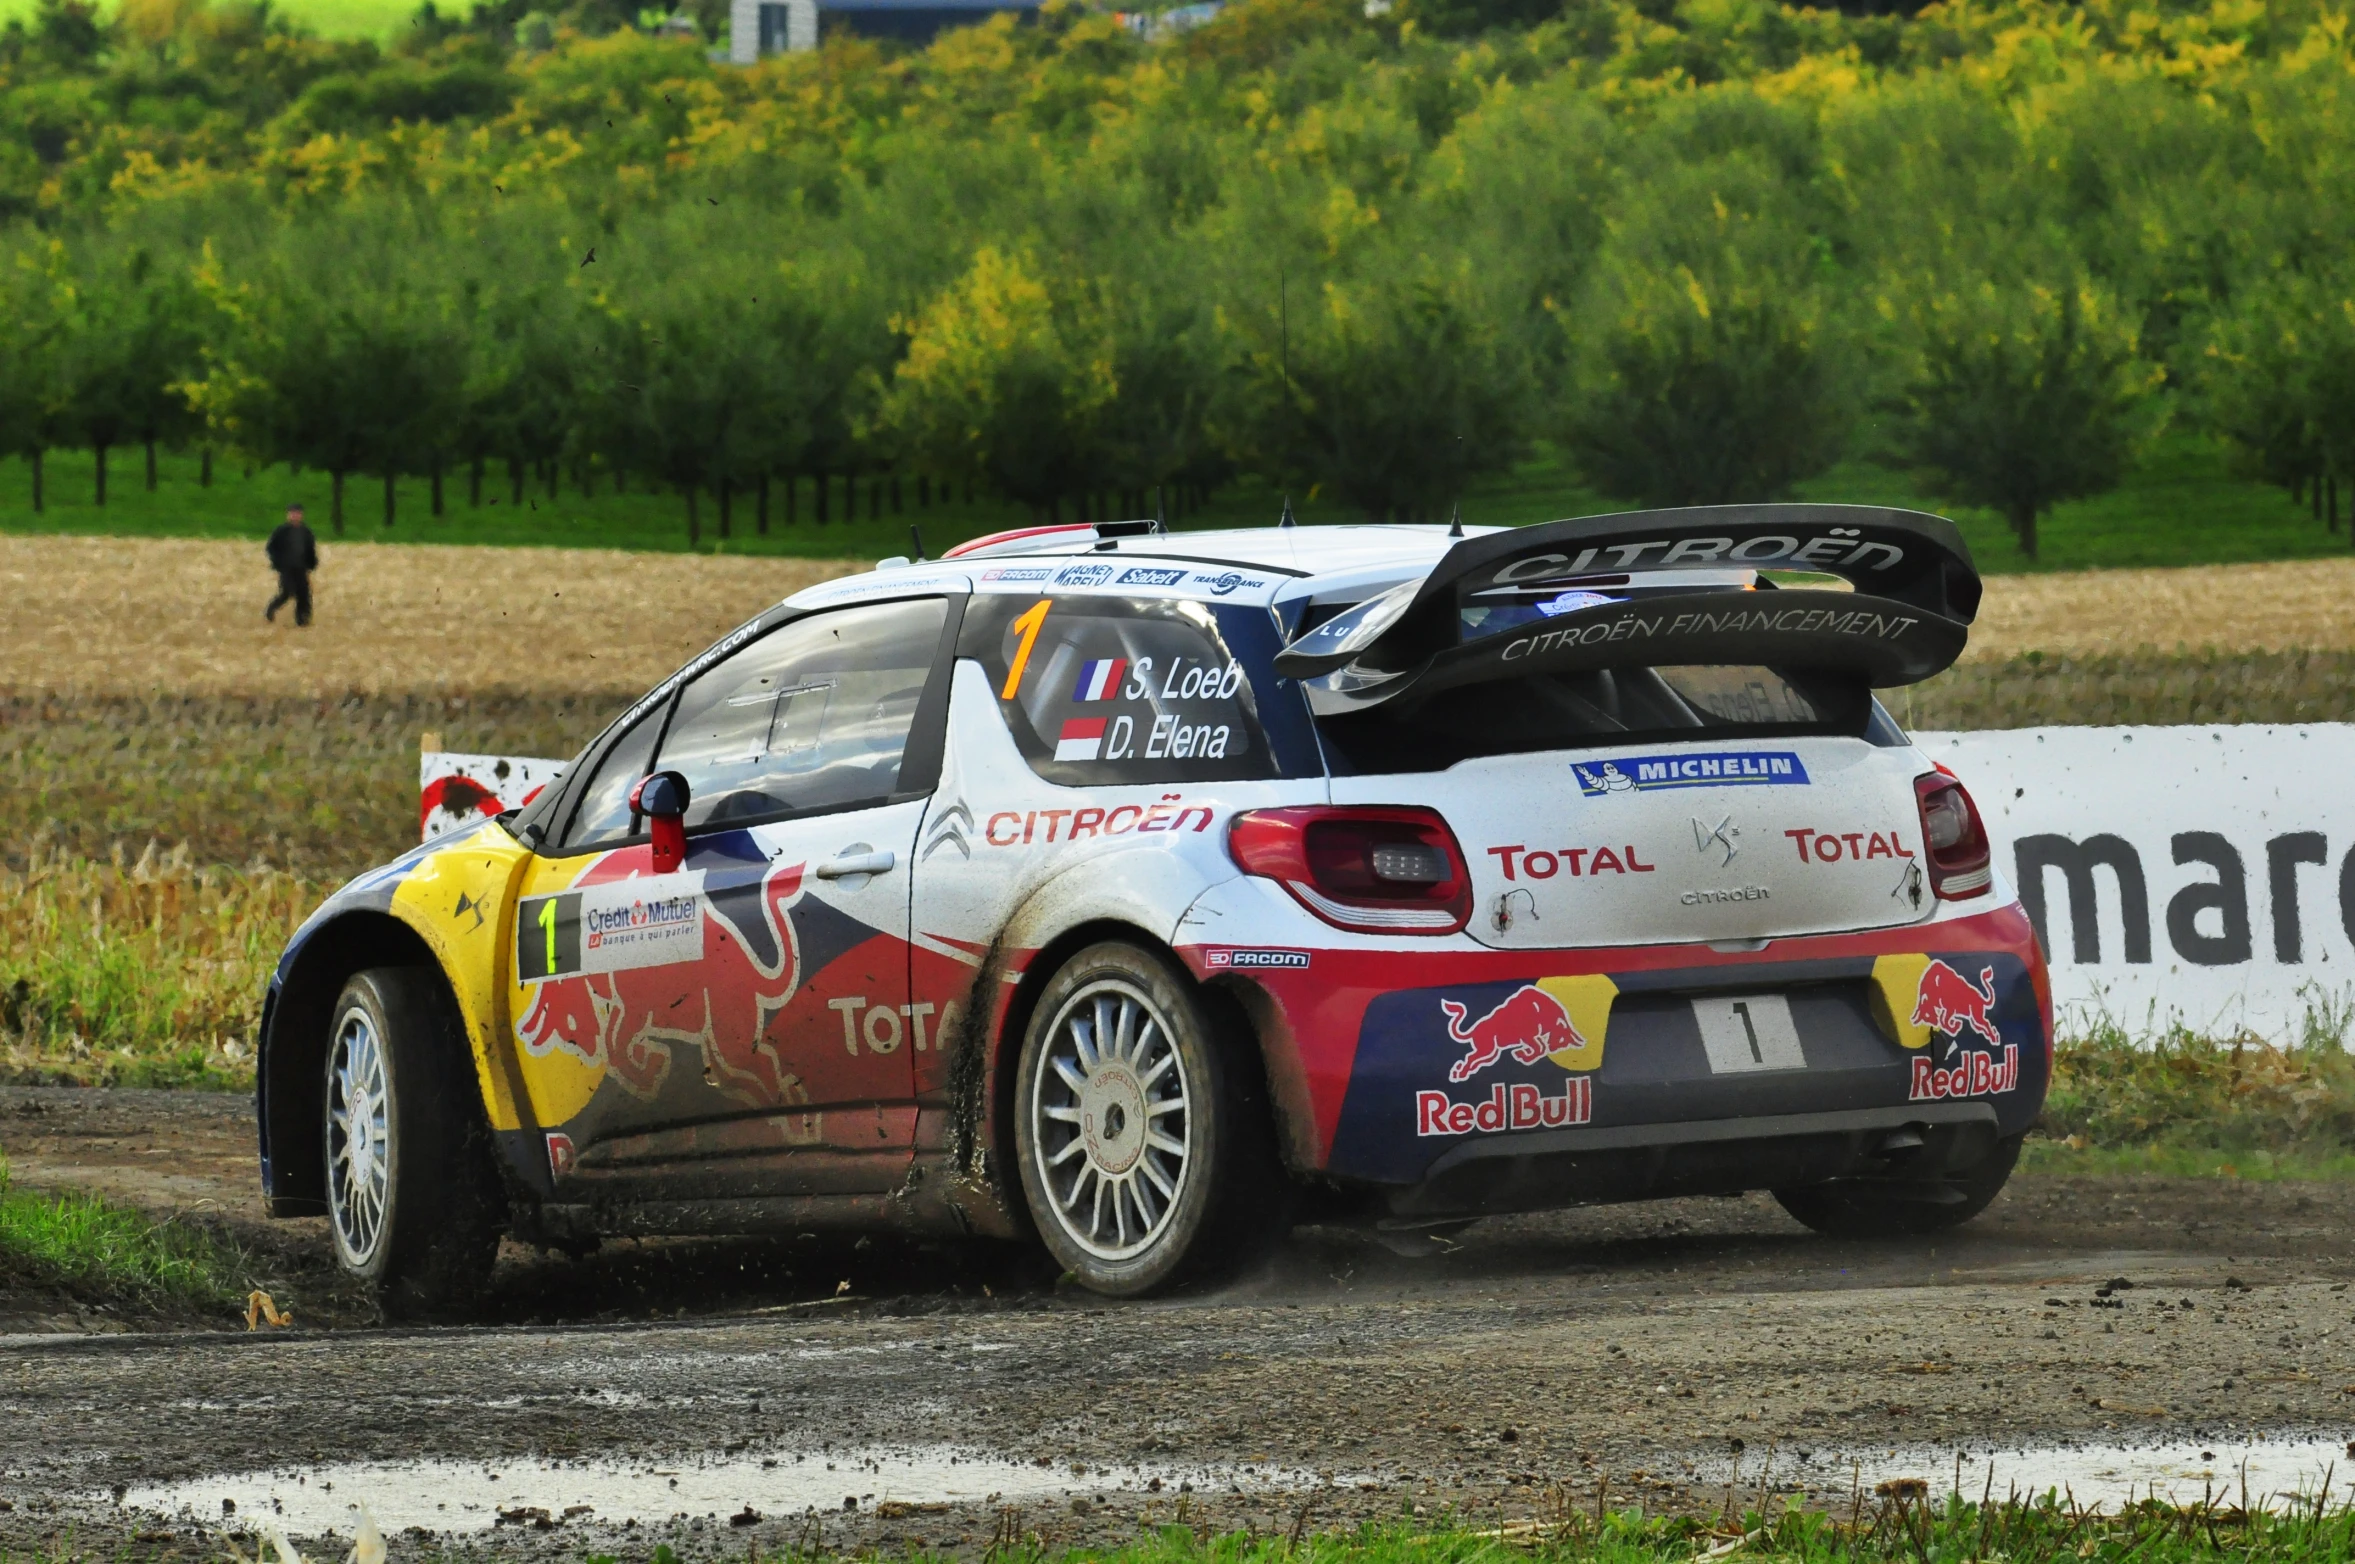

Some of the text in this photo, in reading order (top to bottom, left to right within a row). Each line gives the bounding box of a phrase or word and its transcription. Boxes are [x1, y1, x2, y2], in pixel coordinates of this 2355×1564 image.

[1003, 570, 1049, 580] FACOM
[1124, 569, 1180, 585] Sabelt
[1001, 600, 1052, 699] 1
[1501, 609, 1919, 661] CITROËN FINANCEMENT
[1125, 657, 1243, 700] S. Loeb
[1104, 715, 1231, 759] D. Elena
[1638, 754, 1793, 780] MICHELIN
[1488, 845, 1655, 881] TOTAL
[588, 896, 697, 932] Crédit Mutuel
[2013, 831, 2355, 966] mar
[537, 898, 558, 975] 1
[603, 932, 635, 946] banque
[666, 925, 695, 940] parler
[1233, 952, 1308, 967] FACOM
[1733, 1002, 1763, 1064] 1
[1910, 1043, 2019, 1100] Red Bull
[1416, 1075, 1592, 1137] Red Bull
